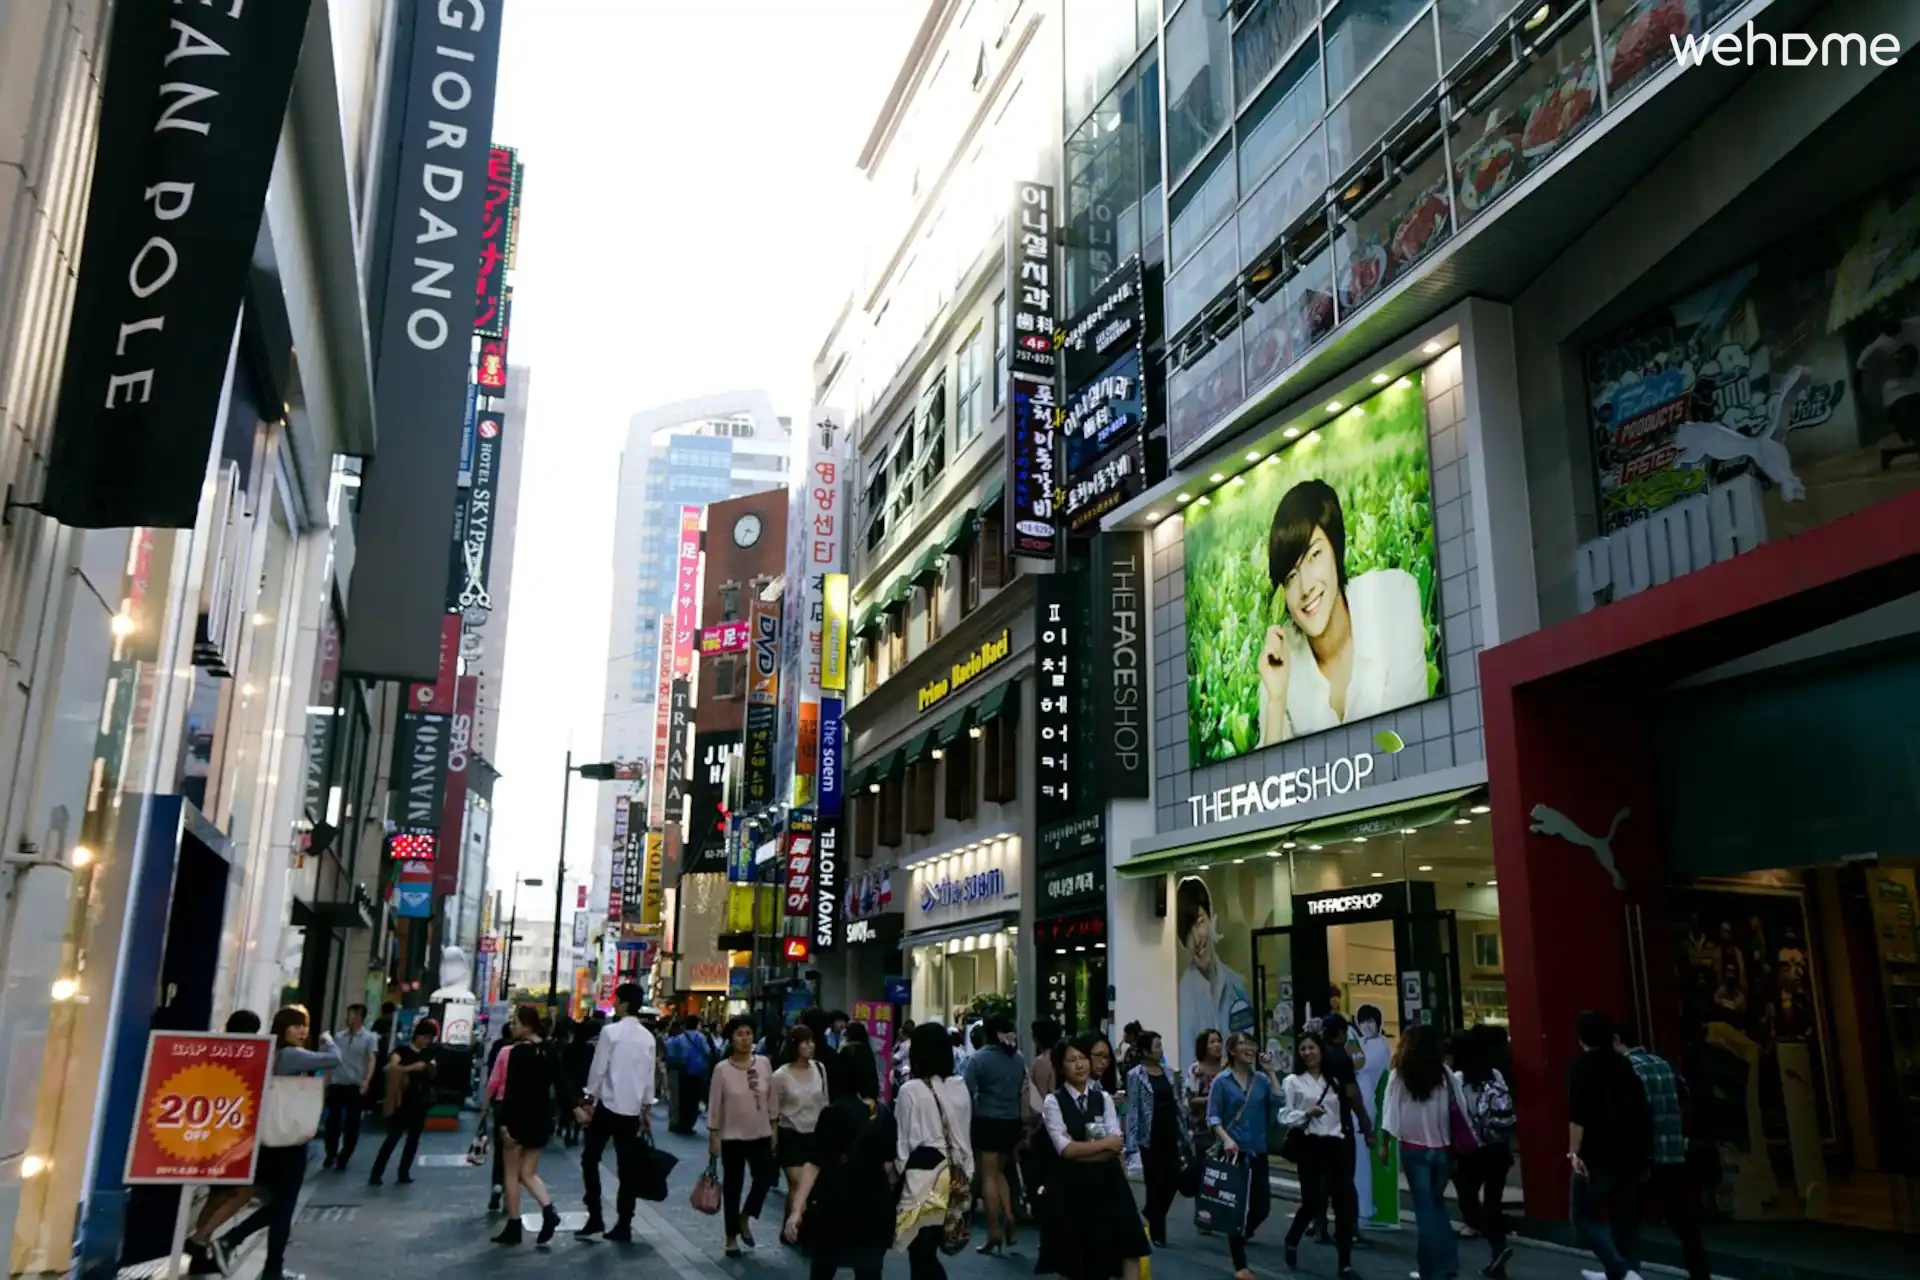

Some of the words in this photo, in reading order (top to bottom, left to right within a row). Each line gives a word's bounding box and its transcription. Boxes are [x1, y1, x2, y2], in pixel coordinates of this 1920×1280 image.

[407, 0, 486, 351] GIORDANO
[105, 181, 195, 410] POLE
[477, 442, 493, 485] HOTEL
[677, 542, 698, 643] 足マッサージ
[755, 613, 778, 677] DVD
[1112, 555, 1140, 771] THEFACESHOP
[667, 692, 688, 800] TRIANA
[822, 718, 836, 746] the
[407, 725, 440, 821] MANGO
[822, 748, 836, 793] saem
[1188, 752, 1375, 827] THEFACESHOP
[819, 827, 836, 888] HOTEL
[817, 889, 835, 947] SAVOY
[1307, 893, 1384, 916] THEFACESHOP
[155, 1094, 245, 1129] 20%
[182, 1129, 212, 1141] OFF
